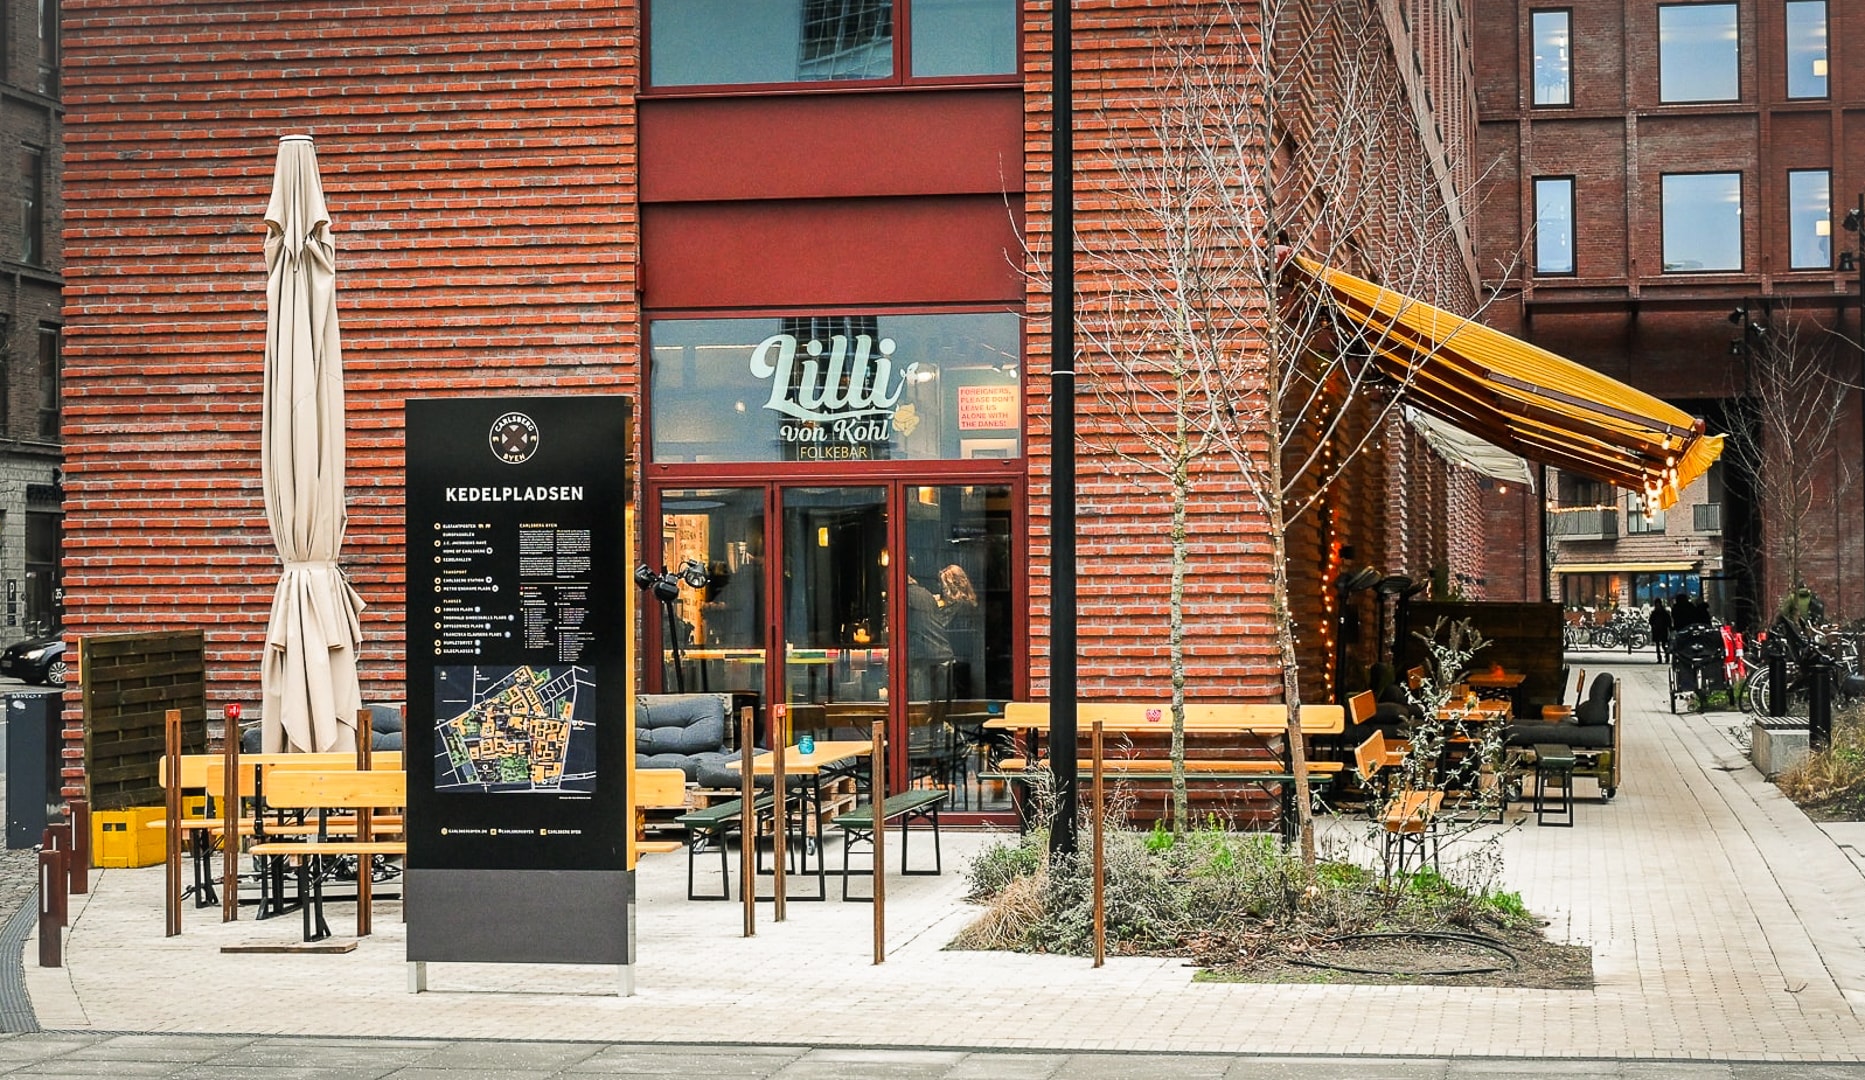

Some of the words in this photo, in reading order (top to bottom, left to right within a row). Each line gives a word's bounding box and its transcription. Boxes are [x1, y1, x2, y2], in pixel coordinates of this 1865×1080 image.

[750, 334, 919, 422] Lilli
[960, 396, 990, 404] PLEASE
[960, 404, 985, 412] LEAVE
[494, 415, 535, 432] CARLSBERG
[961, 420, 977, 428] THE
[780, 425, 828, 442] von
[833, 419, 890, 443] Kohl
[502, 453, 526, 462] BYEN
[800, 446, 868, 459] FOLKEBAR
[445, 486, 584, 502] KEDELPLADSEN
